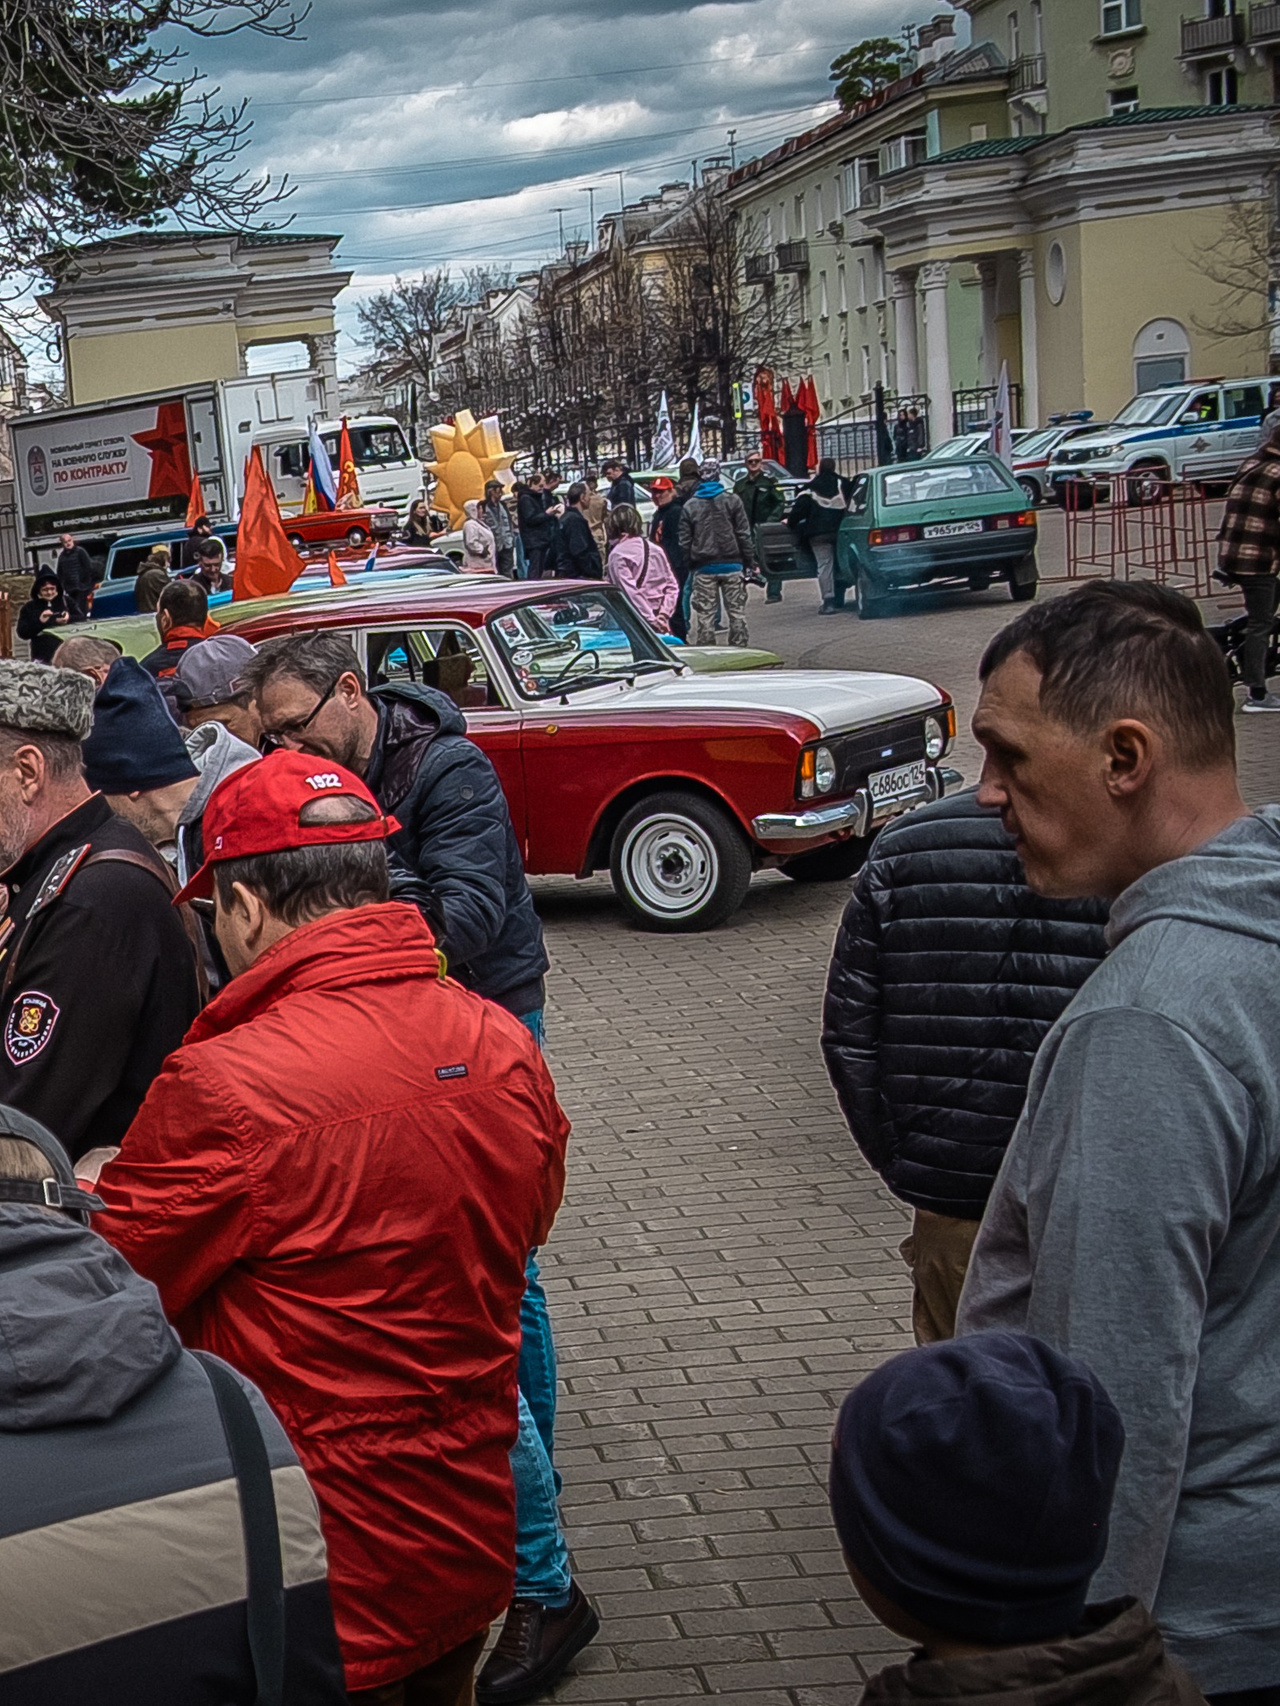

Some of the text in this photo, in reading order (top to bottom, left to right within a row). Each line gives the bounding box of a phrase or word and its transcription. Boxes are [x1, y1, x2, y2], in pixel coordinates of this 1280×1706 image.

[51, 448, 127, 468] НА ВОЕННУЮ СЛУЖБУ
[54, 470, 69, 484] ПО
[70, 461, 128, 481] КОНТРАКТУ
[305, 773, 342, 790] 1922
